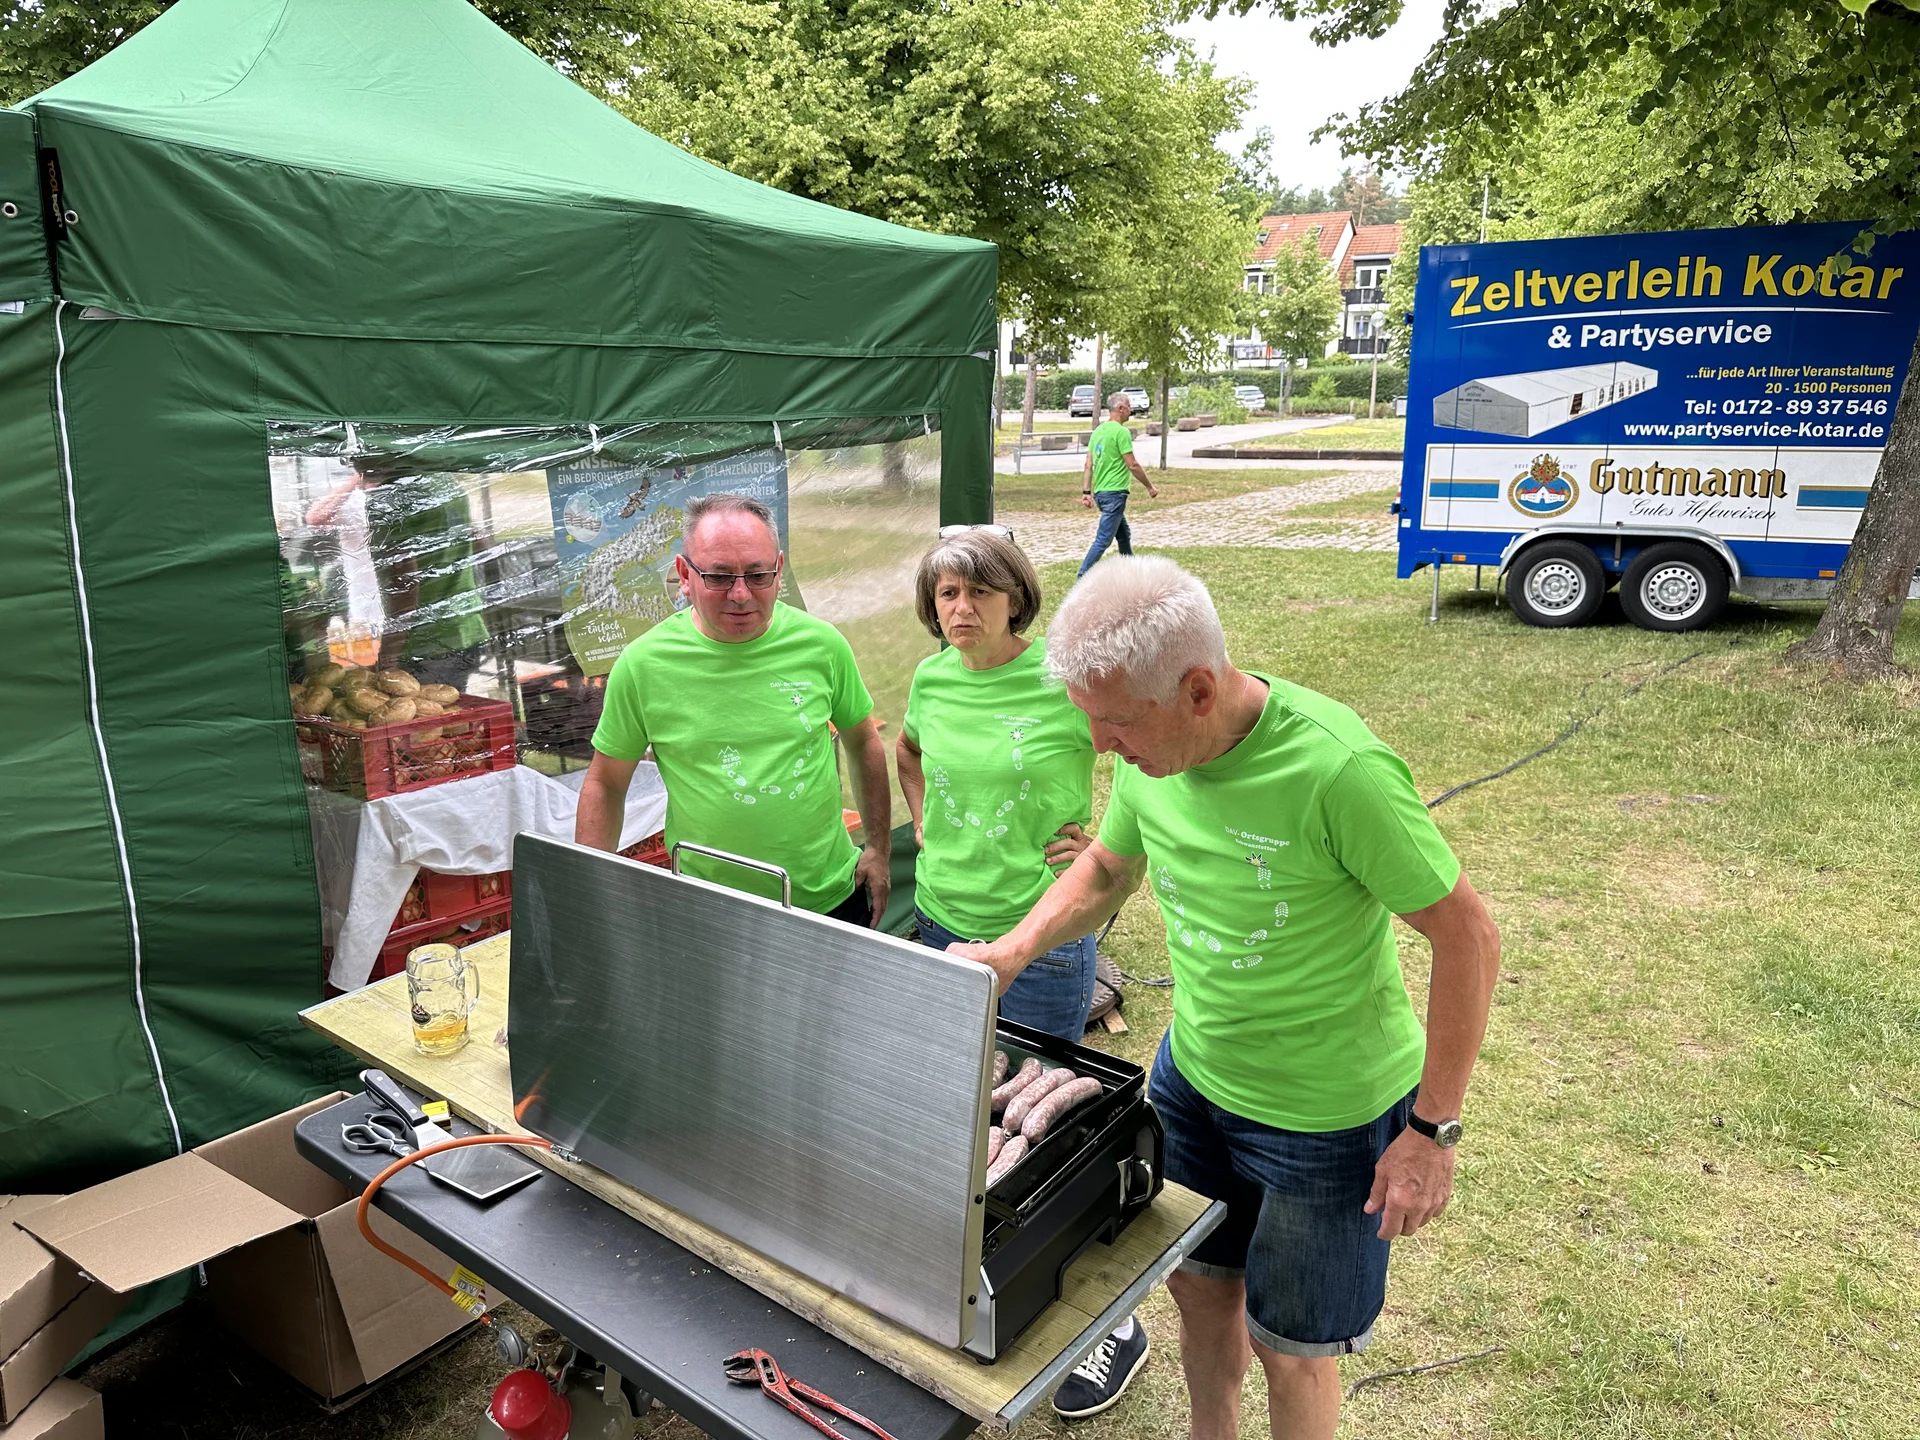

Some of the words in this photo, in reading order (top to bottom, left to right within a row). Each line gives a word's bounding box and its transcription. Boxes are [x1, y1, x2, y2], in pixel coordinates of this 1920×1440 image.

[47, 160, 63, 228] TOOLPORT
[1451, 256, 1722, 317] Zeltverleih
[1743, 254, 1904, 299] Kotar
[1548, 325, 1571, 349] &
[1580, 319, 1772, 351] Partyservice
[1717, 366, 1744, 380] jede
[1747, 366, 1767, 377] Art
[1769, 365, 1800, 377] Ihrer
[1803, 364, 1895, 379] Veranstaltung
[1765, 382, 1782, 394] 20
[1793, 382, 1827, 394] 1500
[1829, 381, 1891, 394] Personen
[1684, 399, 1717, 415] Tel:
[1722, 399, 1773, 415] 0172
[1785, 399, 1813, 415] 89
[1624, 421, 1884, 440] www.partyservice-Kotar.de
[558, 474, 572, 484] EIN
[705, 462, 775, 477] PFLANZENARTEN
[1589, 458, 1788, 499] Gutmann
[1629, 498, 1674, 517] Gutes
[1679, 501, 1776, 524] Hefeweizen
